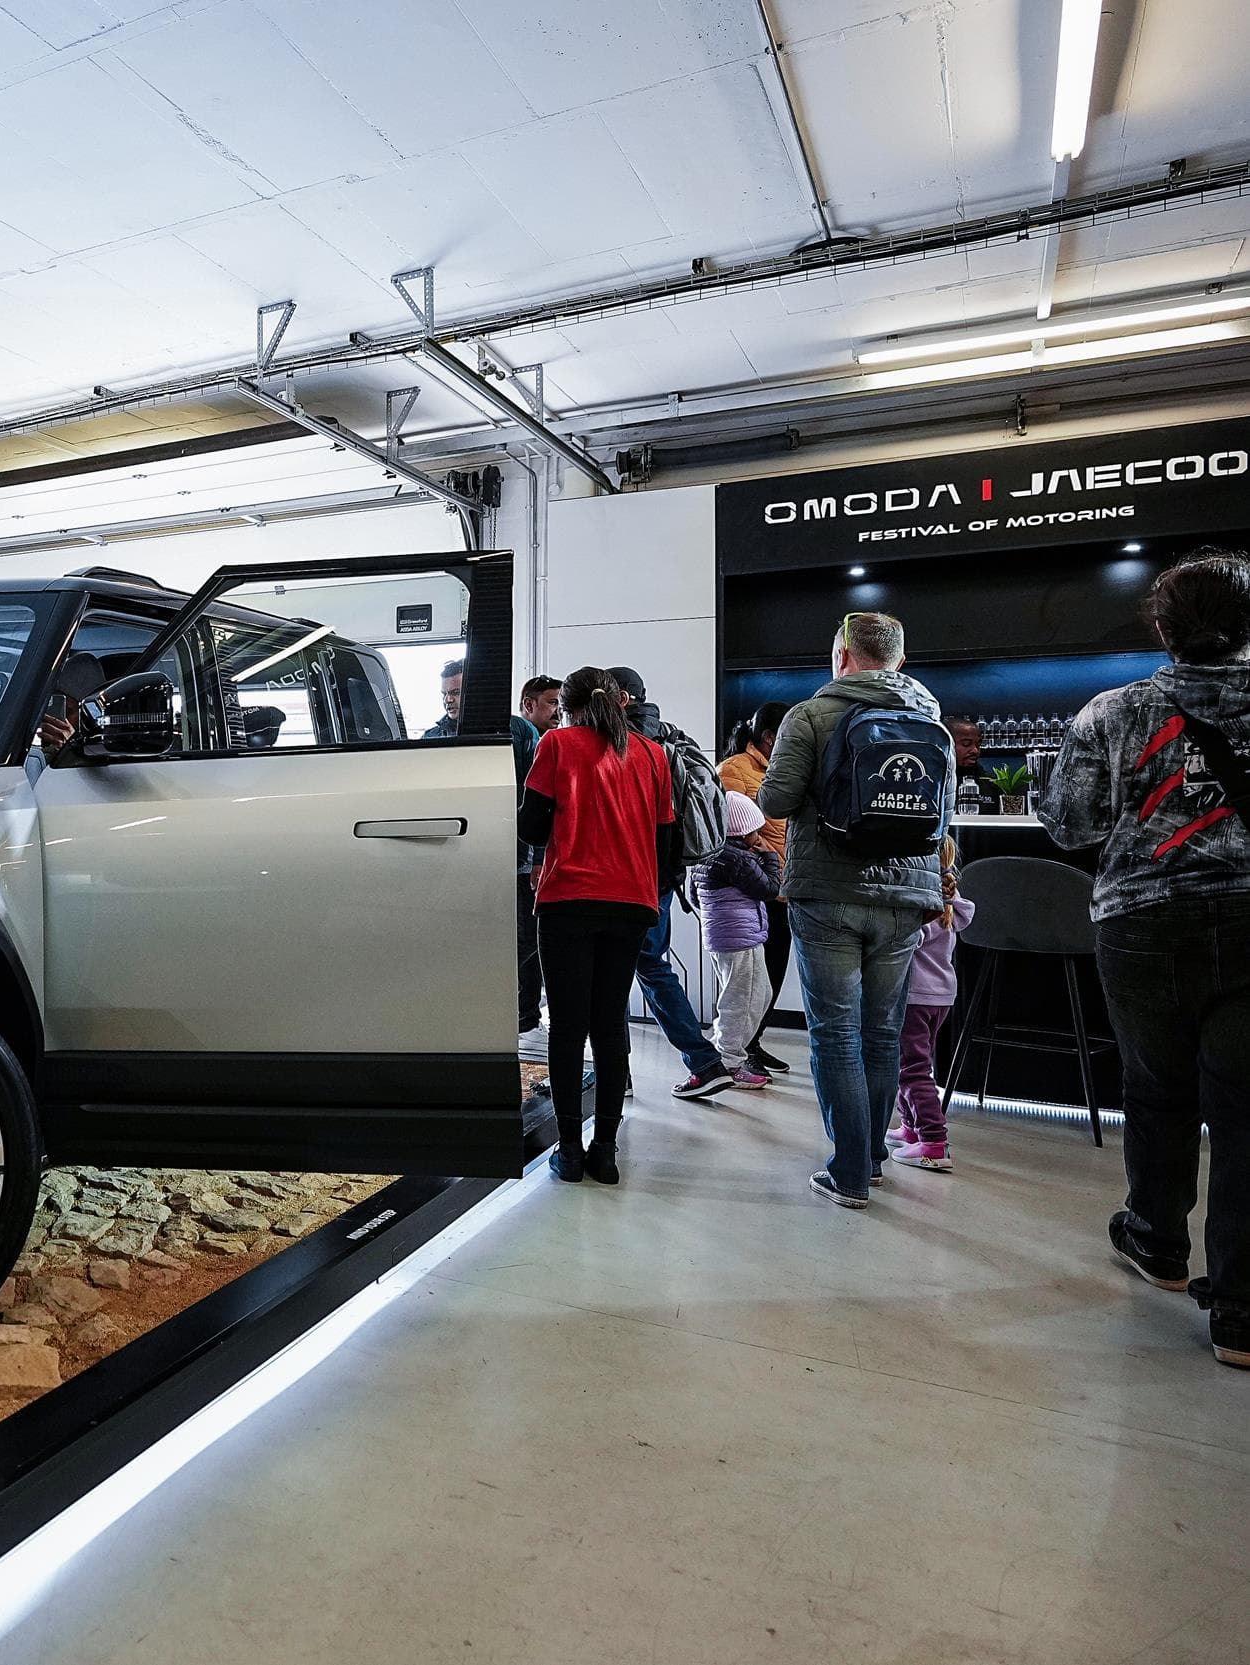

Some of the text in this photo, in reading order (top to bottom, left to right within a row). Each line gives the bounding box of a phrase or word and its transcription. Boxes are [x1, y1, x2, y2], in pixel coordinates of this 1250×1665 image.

[765, 450, 1249, 525] OMODA JAECOO
[858, 505, 1135, 543] FESTIVAL OF MOTORING
[870, 800, 928, 811] BUNDLES
[877, 792, 922, 803] HAPPY
